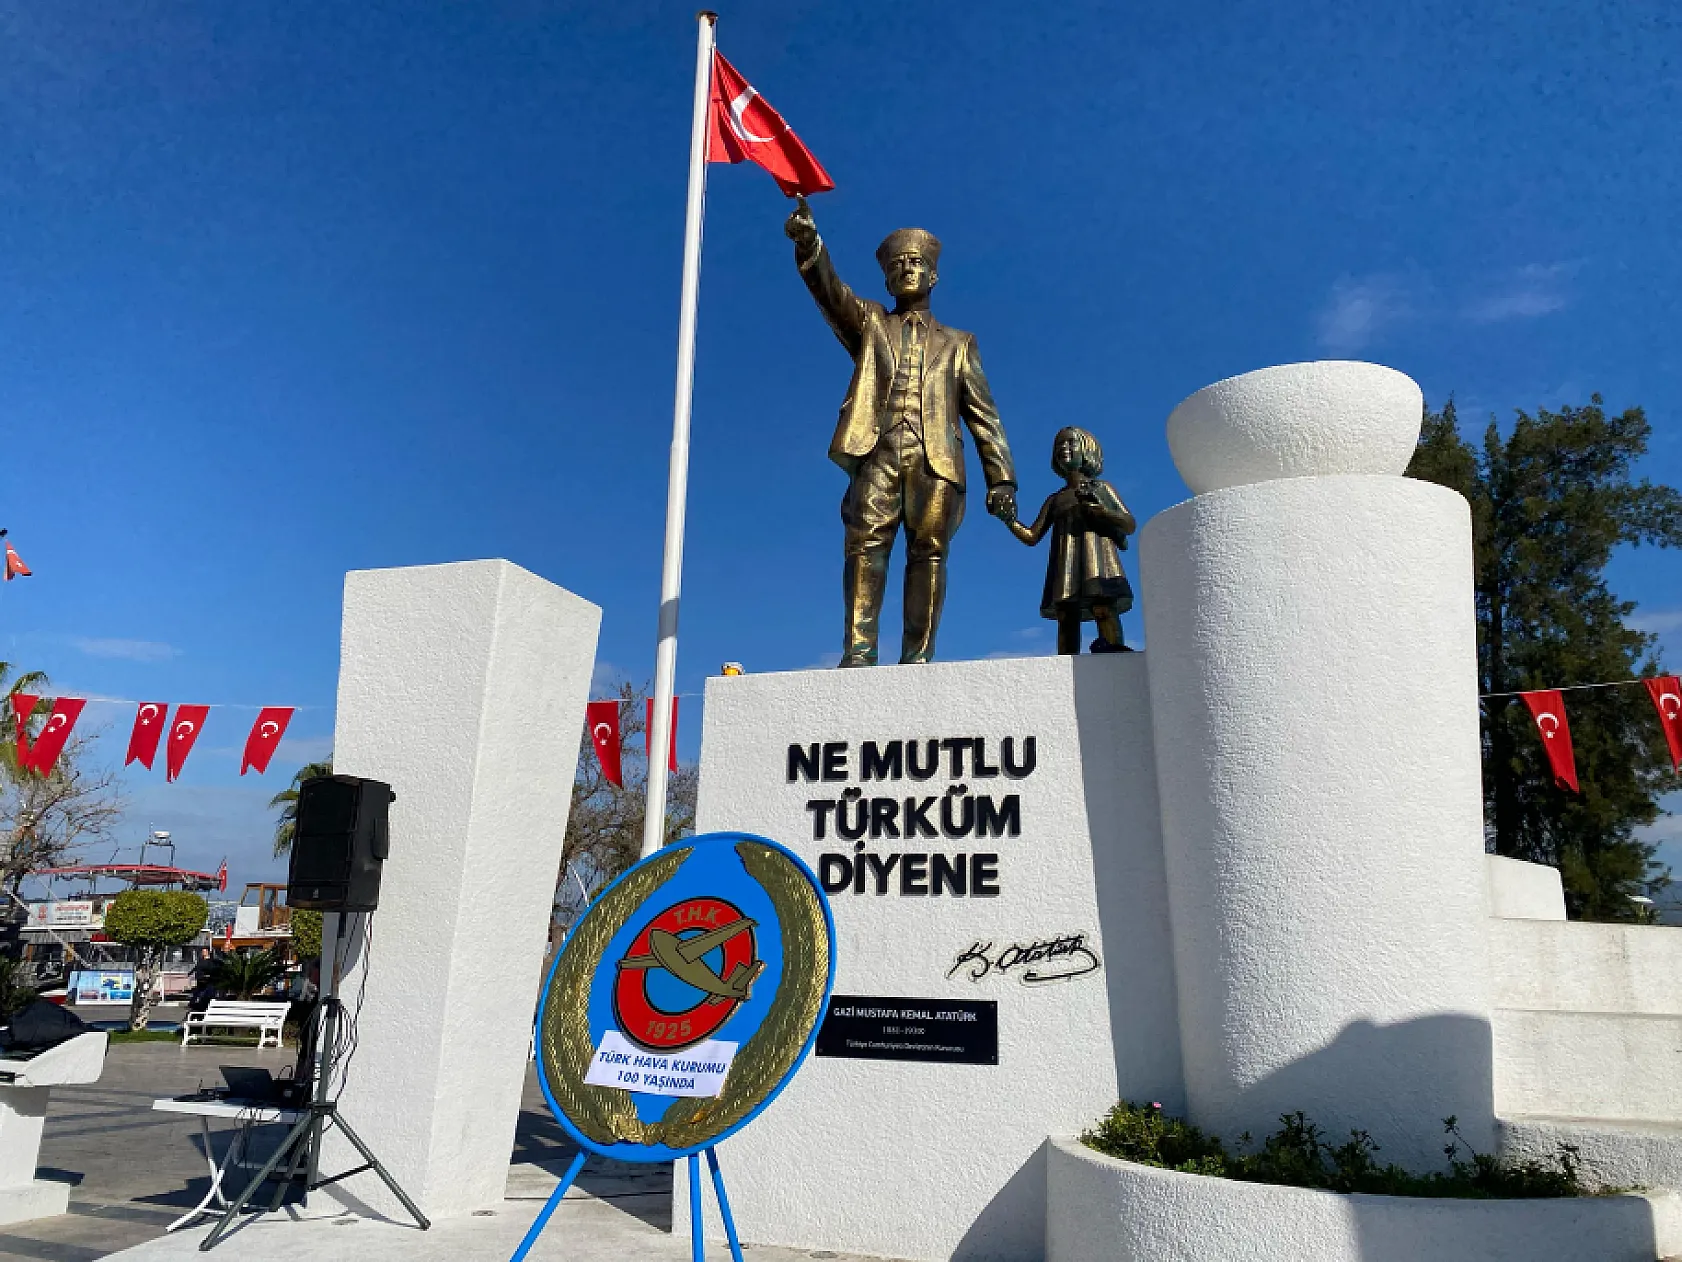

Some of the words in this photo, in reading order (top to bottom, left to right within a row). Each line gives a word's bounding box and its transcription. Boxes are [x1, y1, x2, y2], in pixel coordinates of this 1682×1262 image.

[787, 741, 848, 783] NE
[859, 736, 1036, 781] MUTLU
[806, 784, 1021, 840] TÜRKÜM
[819, 841, 1000, 897] DİYENE
[834, 1006, 855, 1017] GAZİ
[856, 1008, 899, 1019] MUSTAFA
[900, 1009, 934, 1020] KEMAL
[935, 1010, 978, 1022] ATATÜRK
[646, 1018, 692, 1039] 1925
[599, 1050, 631, 1066] TÜRK
[633, 1055, 668, 1070] HAVA
[671, 1059, 726, 1075] KURUMU
[617, 1070, 639, 1084] 100
[643, 1073, 695, 1091] YAŞINDA
